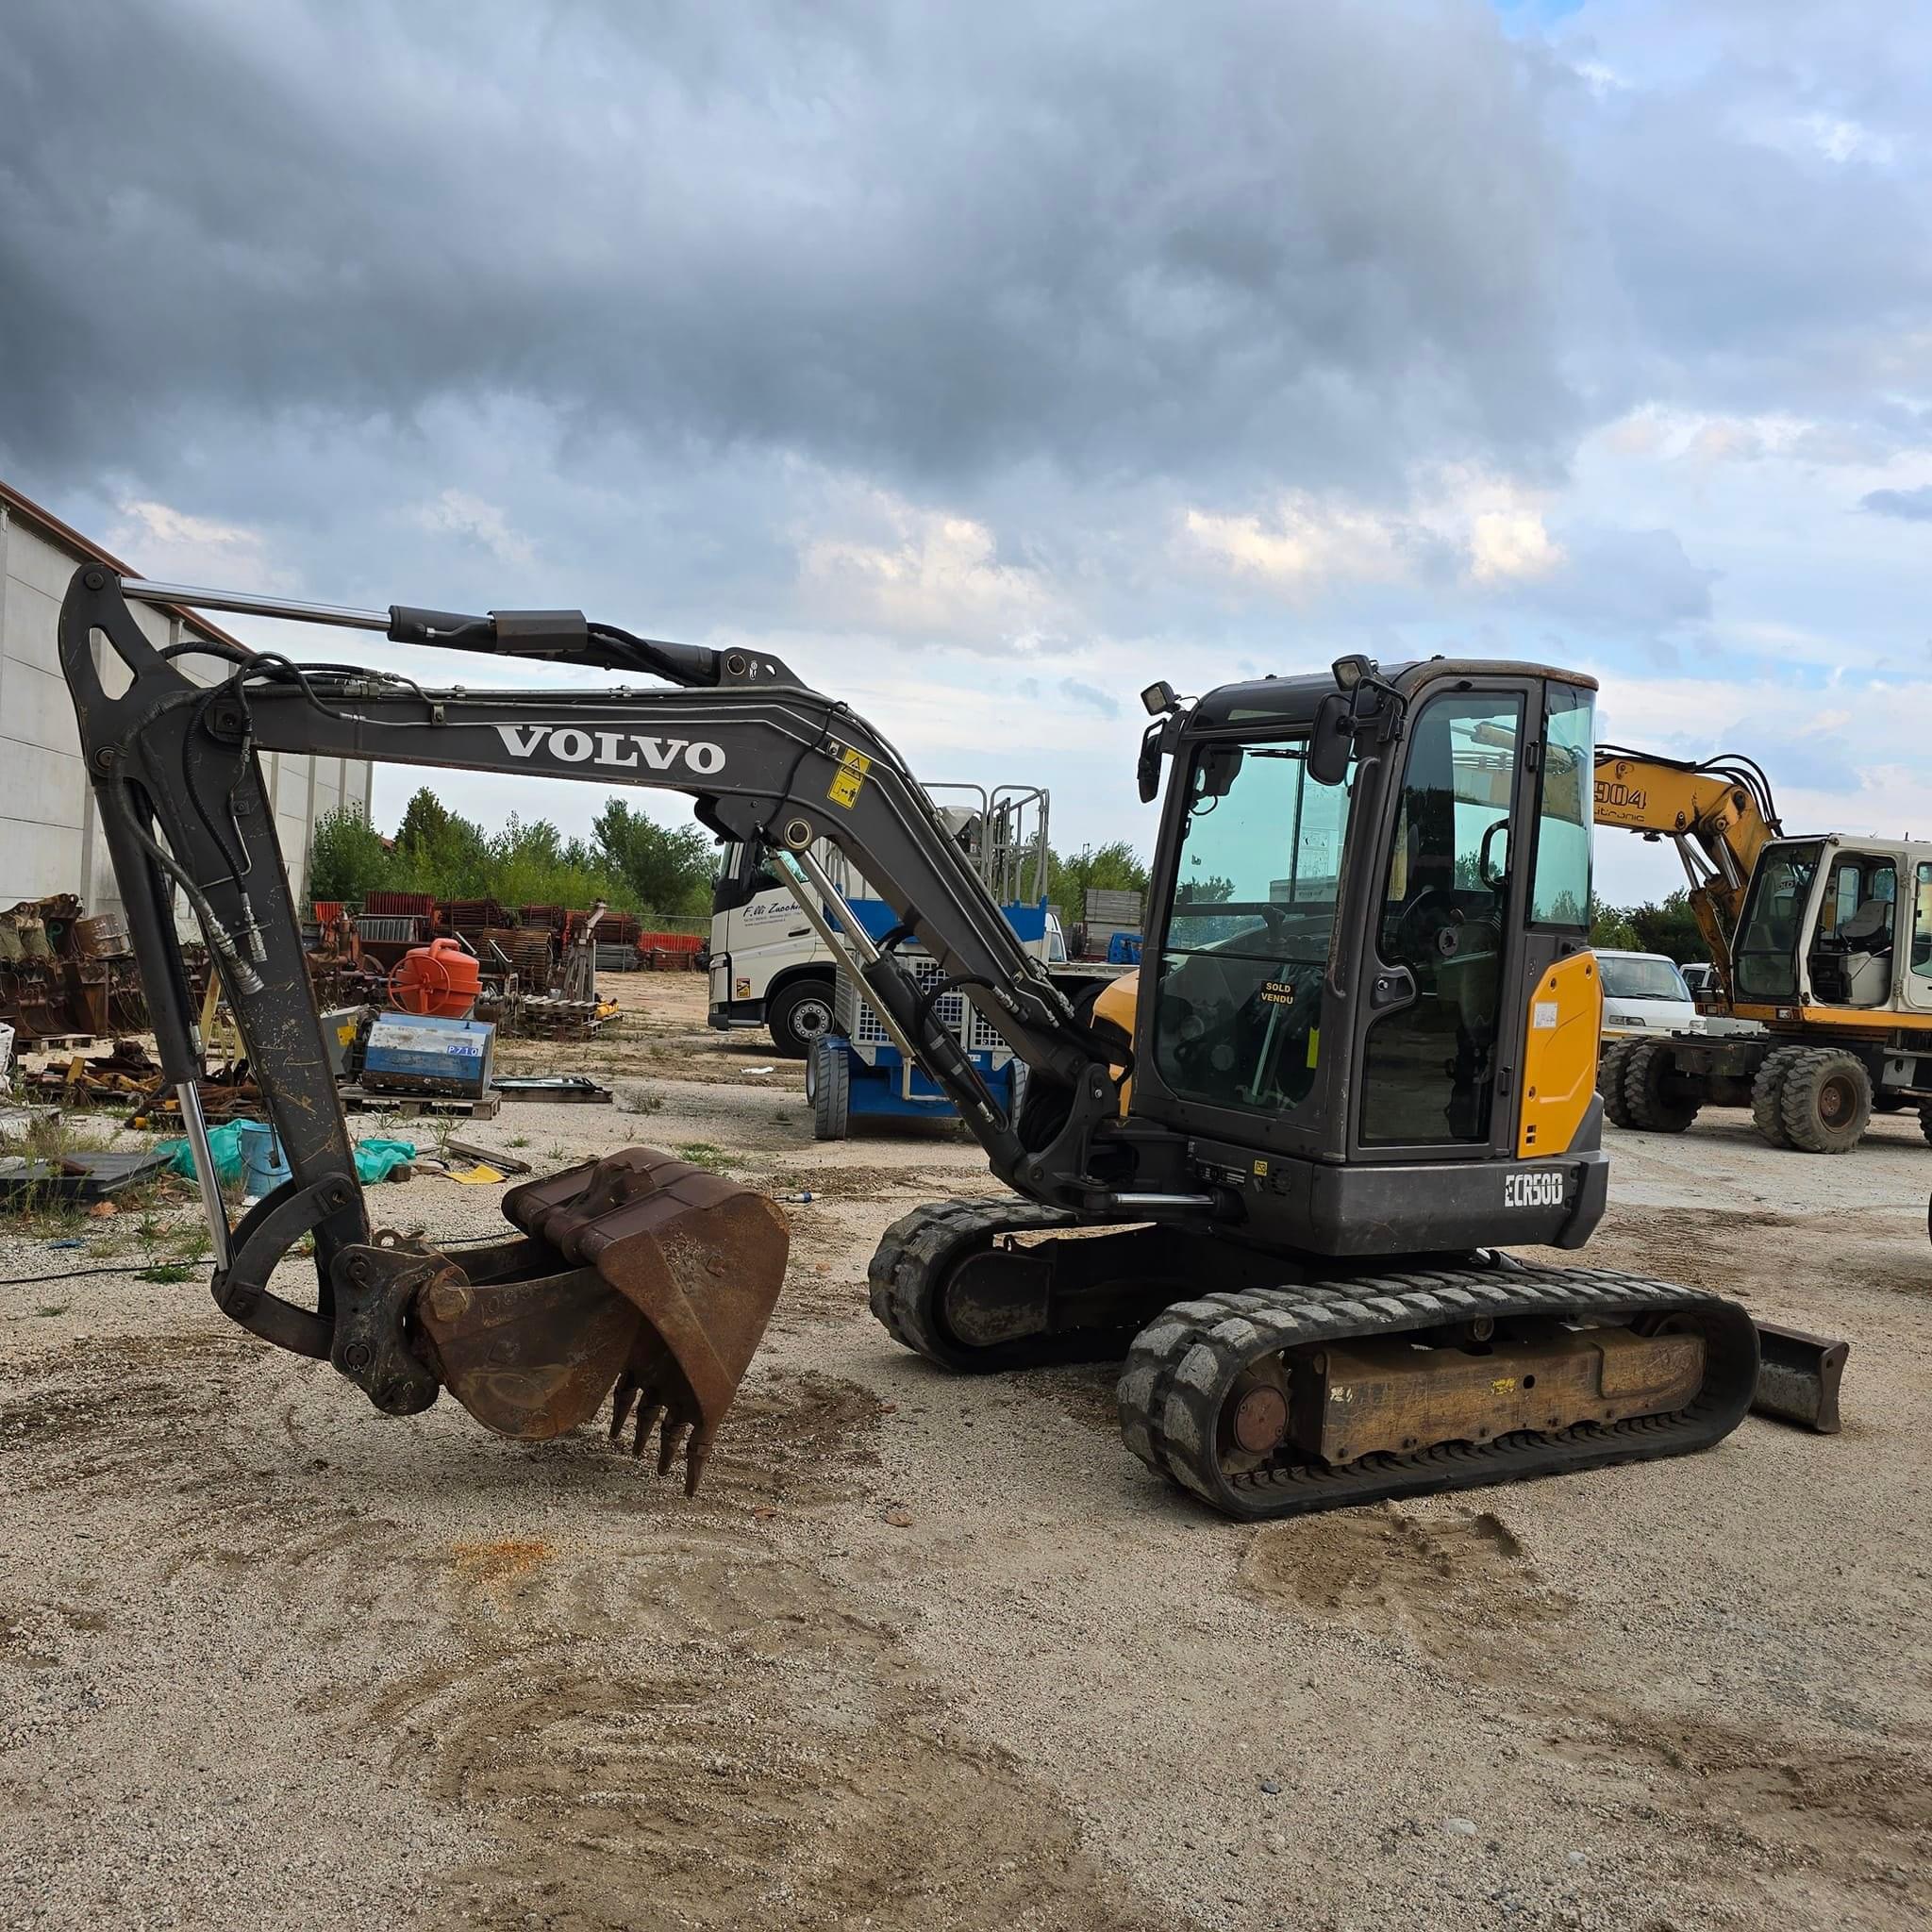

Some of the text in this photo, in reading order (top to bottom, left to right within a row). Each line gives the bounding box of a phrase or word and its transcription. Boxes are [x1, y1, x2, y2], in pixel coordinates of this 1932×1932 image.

[492, 724, 726, 774] VOLVO
[1260, 991, 1294, 1005] VENDU
[1266, 982, 1291, 992] SOLD
[1505, 1173, 1563, 1208] ECR50D
